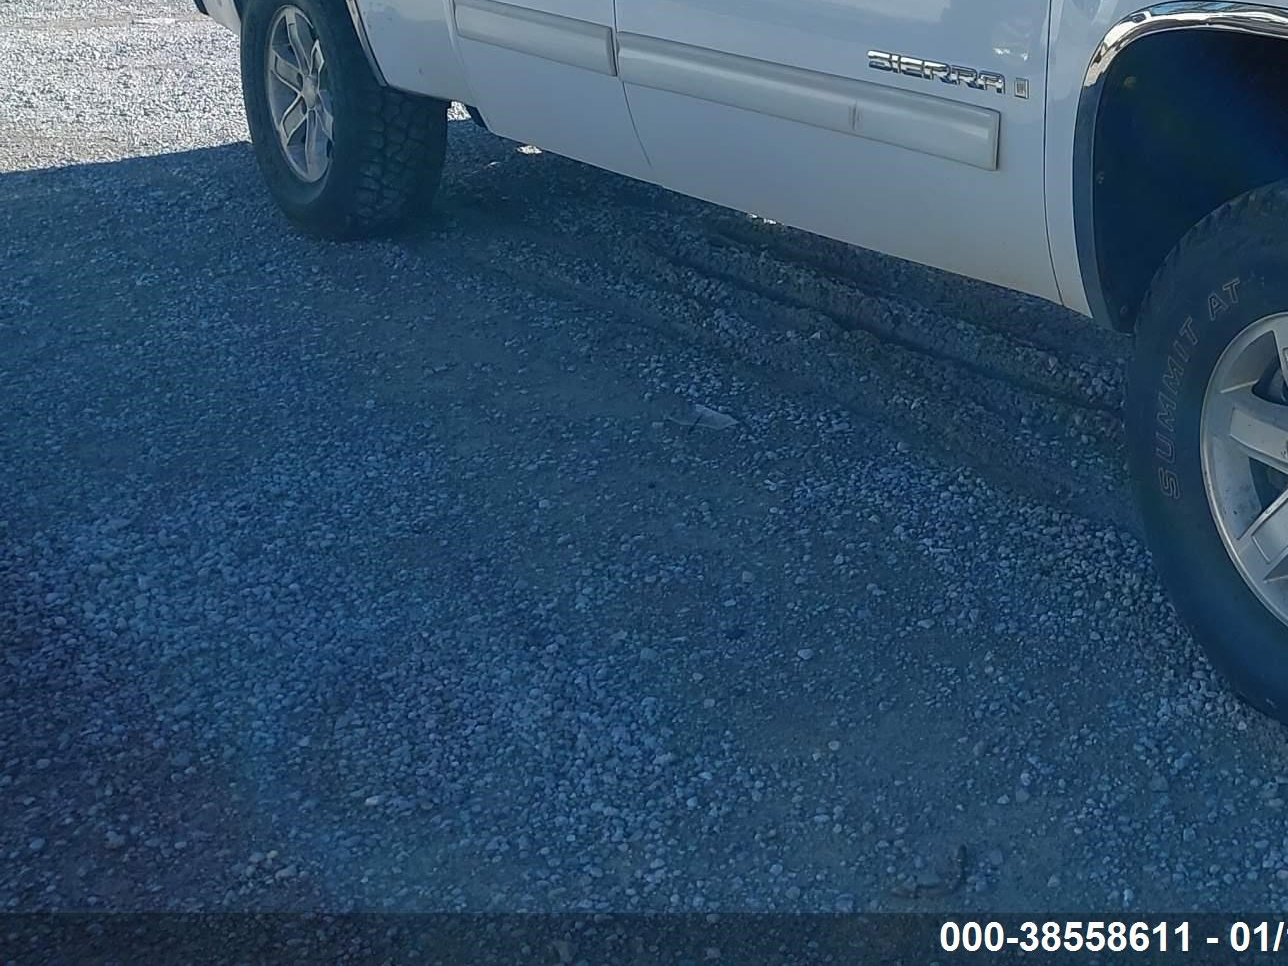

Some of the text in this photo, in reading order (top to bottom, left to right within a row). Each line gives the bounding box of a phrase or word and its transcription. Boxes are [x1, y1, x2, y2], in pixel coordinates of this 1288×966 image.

[867, 49, 1006, 94] SIERRA
[1155, 277, 1241, 501] SUMMIT AT
